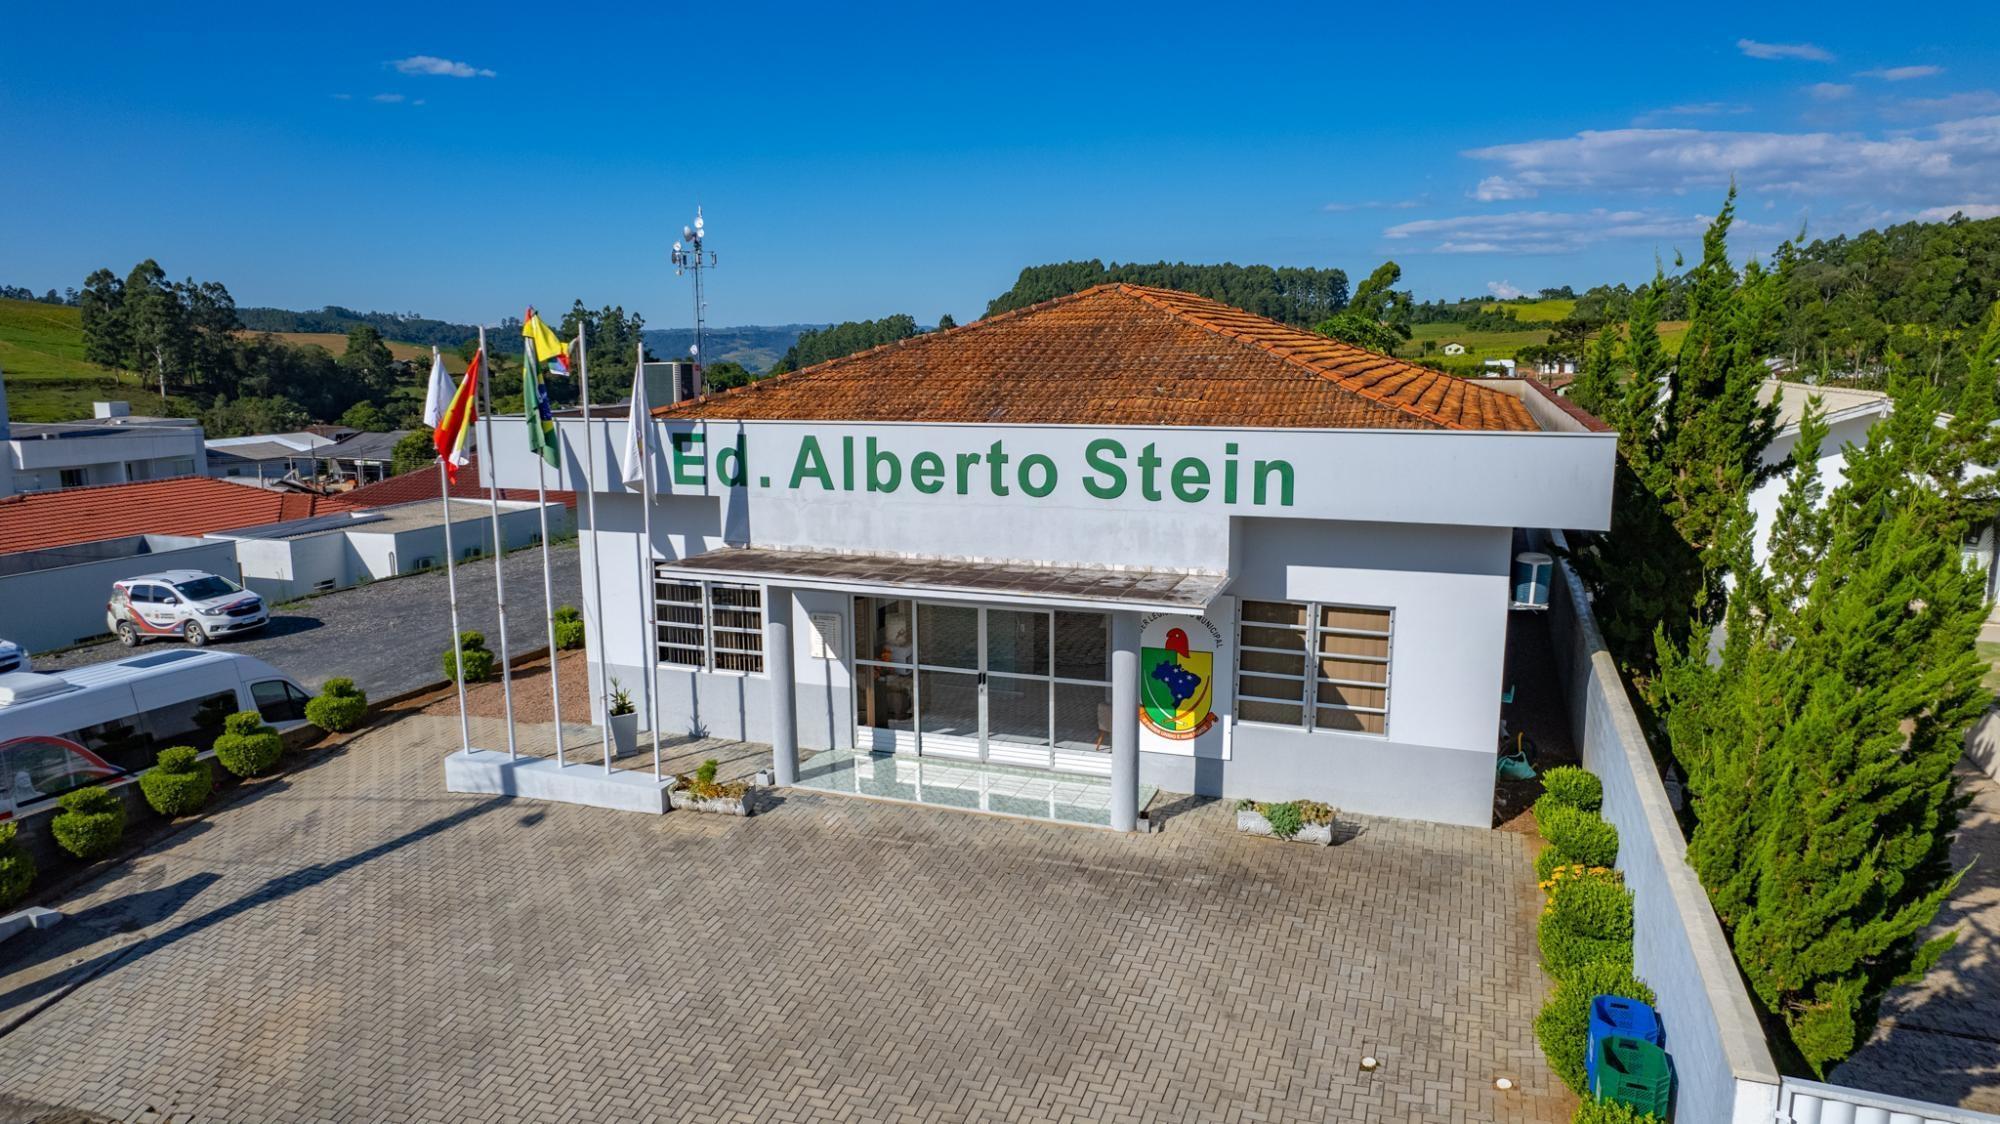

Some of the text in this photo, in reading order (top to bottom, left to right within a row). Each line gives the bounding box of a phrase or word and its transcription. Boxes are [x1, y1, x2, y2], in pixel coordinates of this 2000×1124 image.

[672, 432, 1295, 507] Ed. Alberto Stein
[1196, 615, 1224, 648] MUNICIPAL
